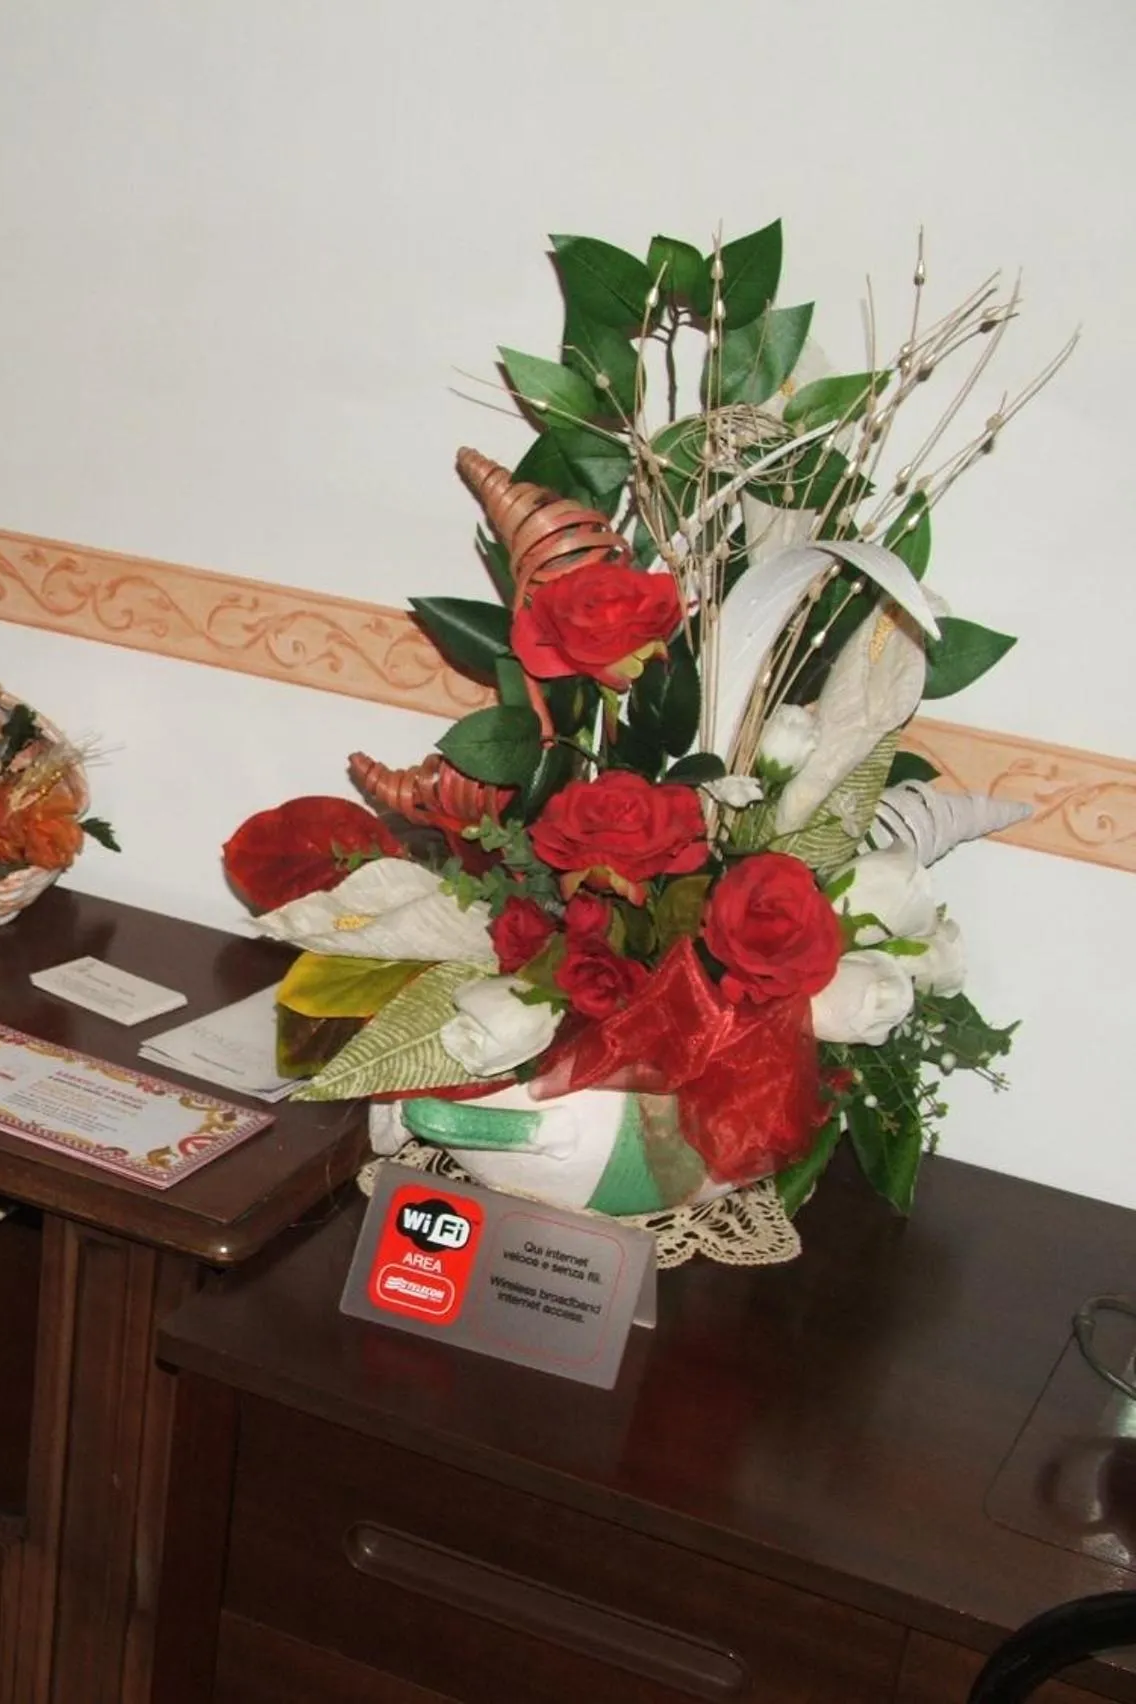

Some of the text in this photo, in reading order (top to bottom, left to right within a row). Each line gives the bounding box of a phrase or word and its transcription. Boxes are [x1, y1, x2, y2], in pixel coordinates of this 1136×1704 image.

[402, 1251, 443, 1274] AREA
[524, 1241, 589, 1267] Qui internet
[551, 1263, 584, 1281] senza
[497, 1291, 541, 1311] internet
[539, 1288, 602, 1315] broadband
